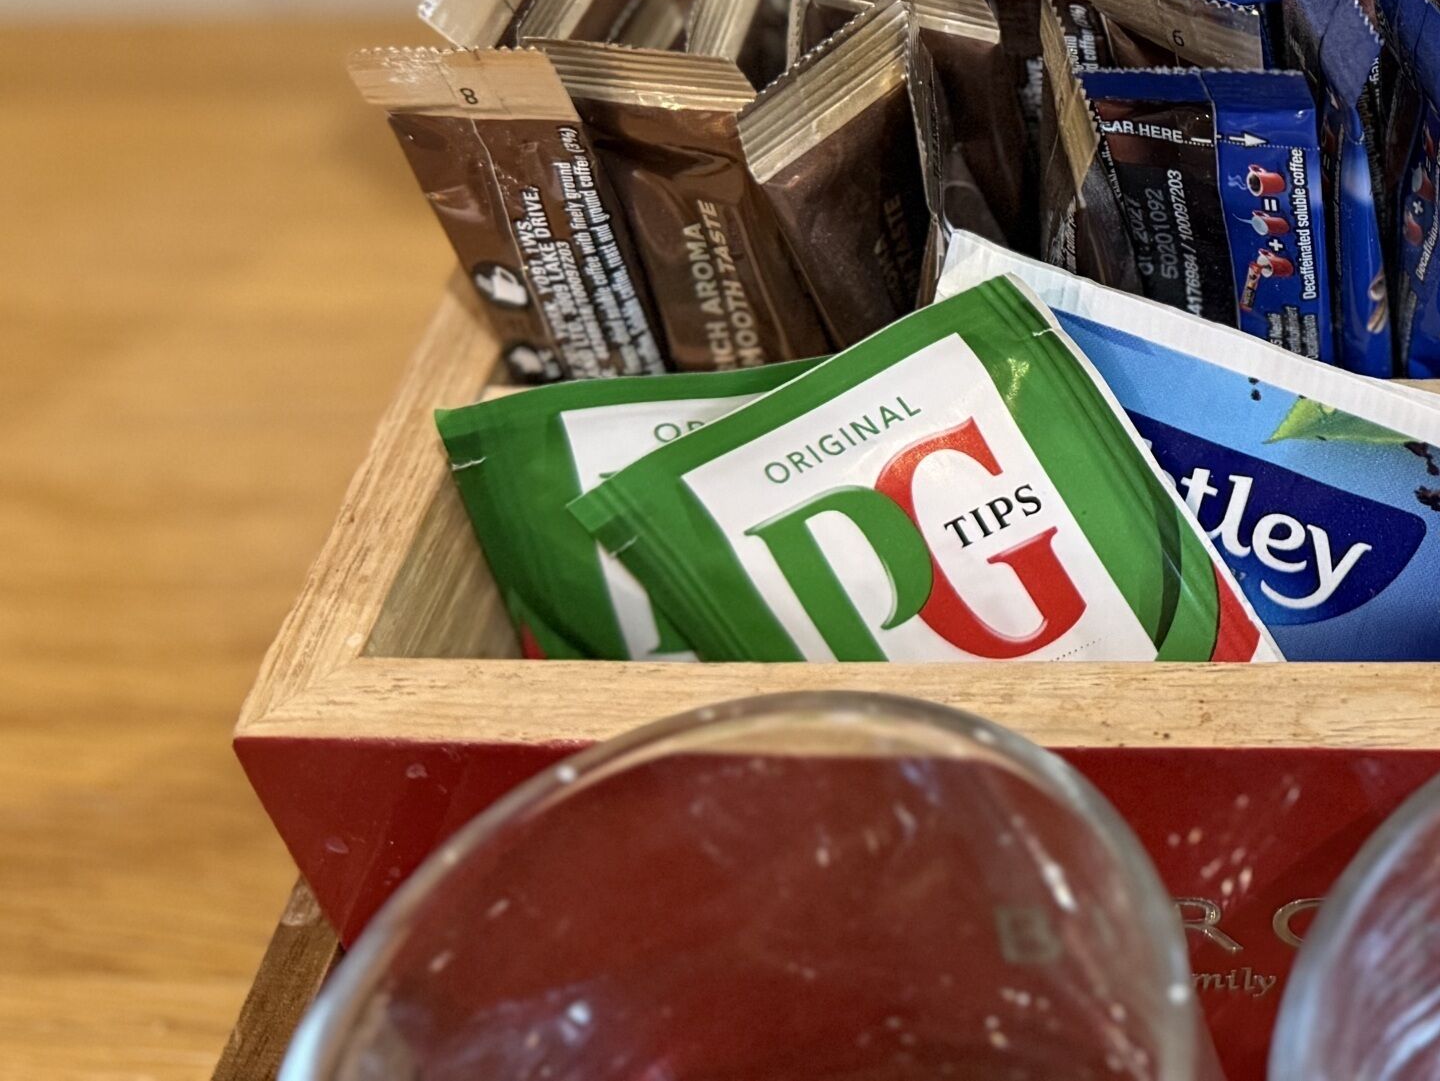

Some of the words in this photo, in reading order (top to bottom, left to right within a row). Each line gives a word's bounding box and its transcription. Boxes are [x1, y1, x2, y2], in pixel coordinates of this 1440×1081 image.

[459, 87, 479, 105] 8
[1101, 119, 1134, 135] EAR
[1138, 123, 1185, 144] HERE
[552, 160, 583, 201] ground
[571, 153, 595, 189] coffee
[1290, 148, 1306, 187] coffee
[563, 200, 589, 231] finely
[582, 188, 611, 224] ground
[1144, 187, 1179, 280] 50201092
[1166, 169, 1194, 242] 100097203
[1293, 186, 1310, 228] soluble
[573, 231, 597, 256] with
[697, 199, 737, 274] TASTE
[1297, 227, 1318, 301] Decaffeinated
[683, 223, 724, 316] AROMA
[1183, 251, 1204, 316] 4176984
[705, 321, 738, 370] ICH
[722, 280, 765, 366] MOOTH
[763, 394, 923, 486] ORIGINAL
[743, 415, 1089, 663] PG
[942, 483, 1045, 551] TIPS
[1163, 460, 1373, 610] tley
[1190, 967, 1277, 998] mily
